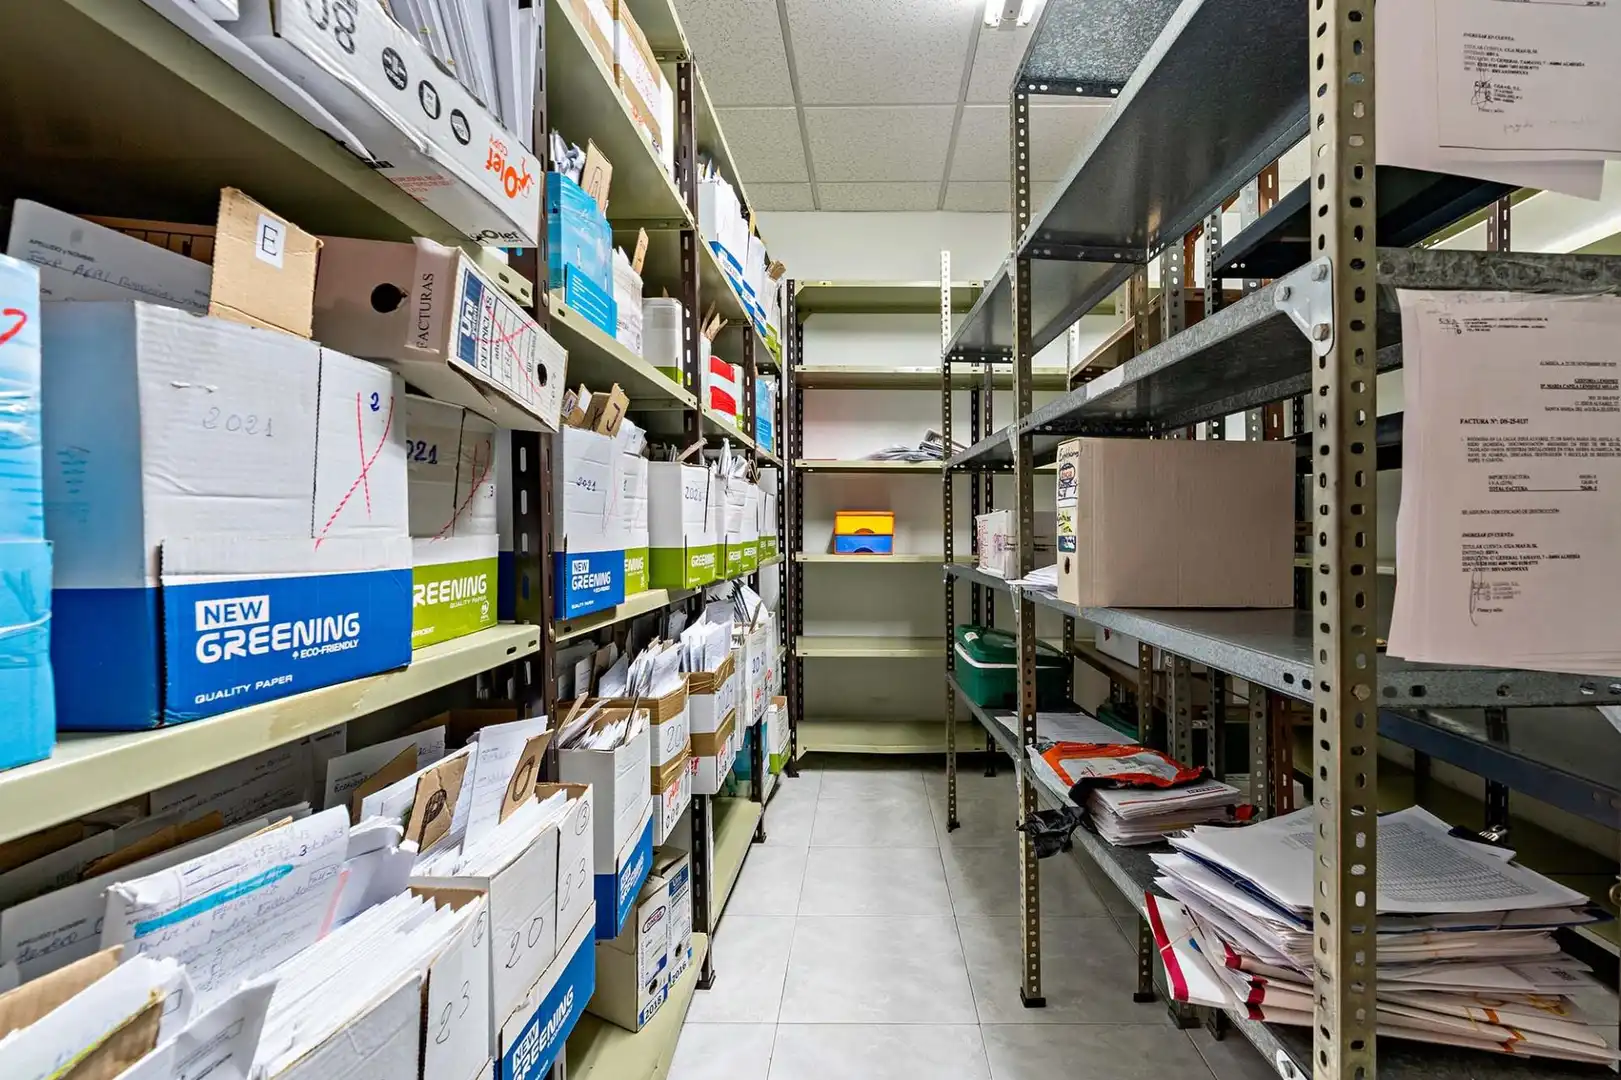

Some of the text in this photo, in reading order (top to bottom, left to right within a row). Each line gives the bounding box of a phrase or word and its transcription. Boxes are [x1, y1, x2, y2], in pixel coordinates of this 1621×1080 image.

[262, 222, 279, 257] E
[415, 273, 434, 349] FACTURAS
[370, 391, 380, 412] 2
[606, 402, 621, 432] J
[202, 406, 275, 438] 2021
[572, 571, 611, 591] GREENING
[575, 562, 587, 575] NEW
[413, 573, 487, 608] REENING
[203, 602, 263, 626] NEW
[195, 612, 361, 664] GREENING
[299, 639, 359, 660] ECO-FRIENDLY
[194, 674, 293, 704] QUALITY PAPER
[505, 916, 544, 969] 20
[436, 980, 472, 1045] 23
[514, 1021, 539, 1071] NEW
